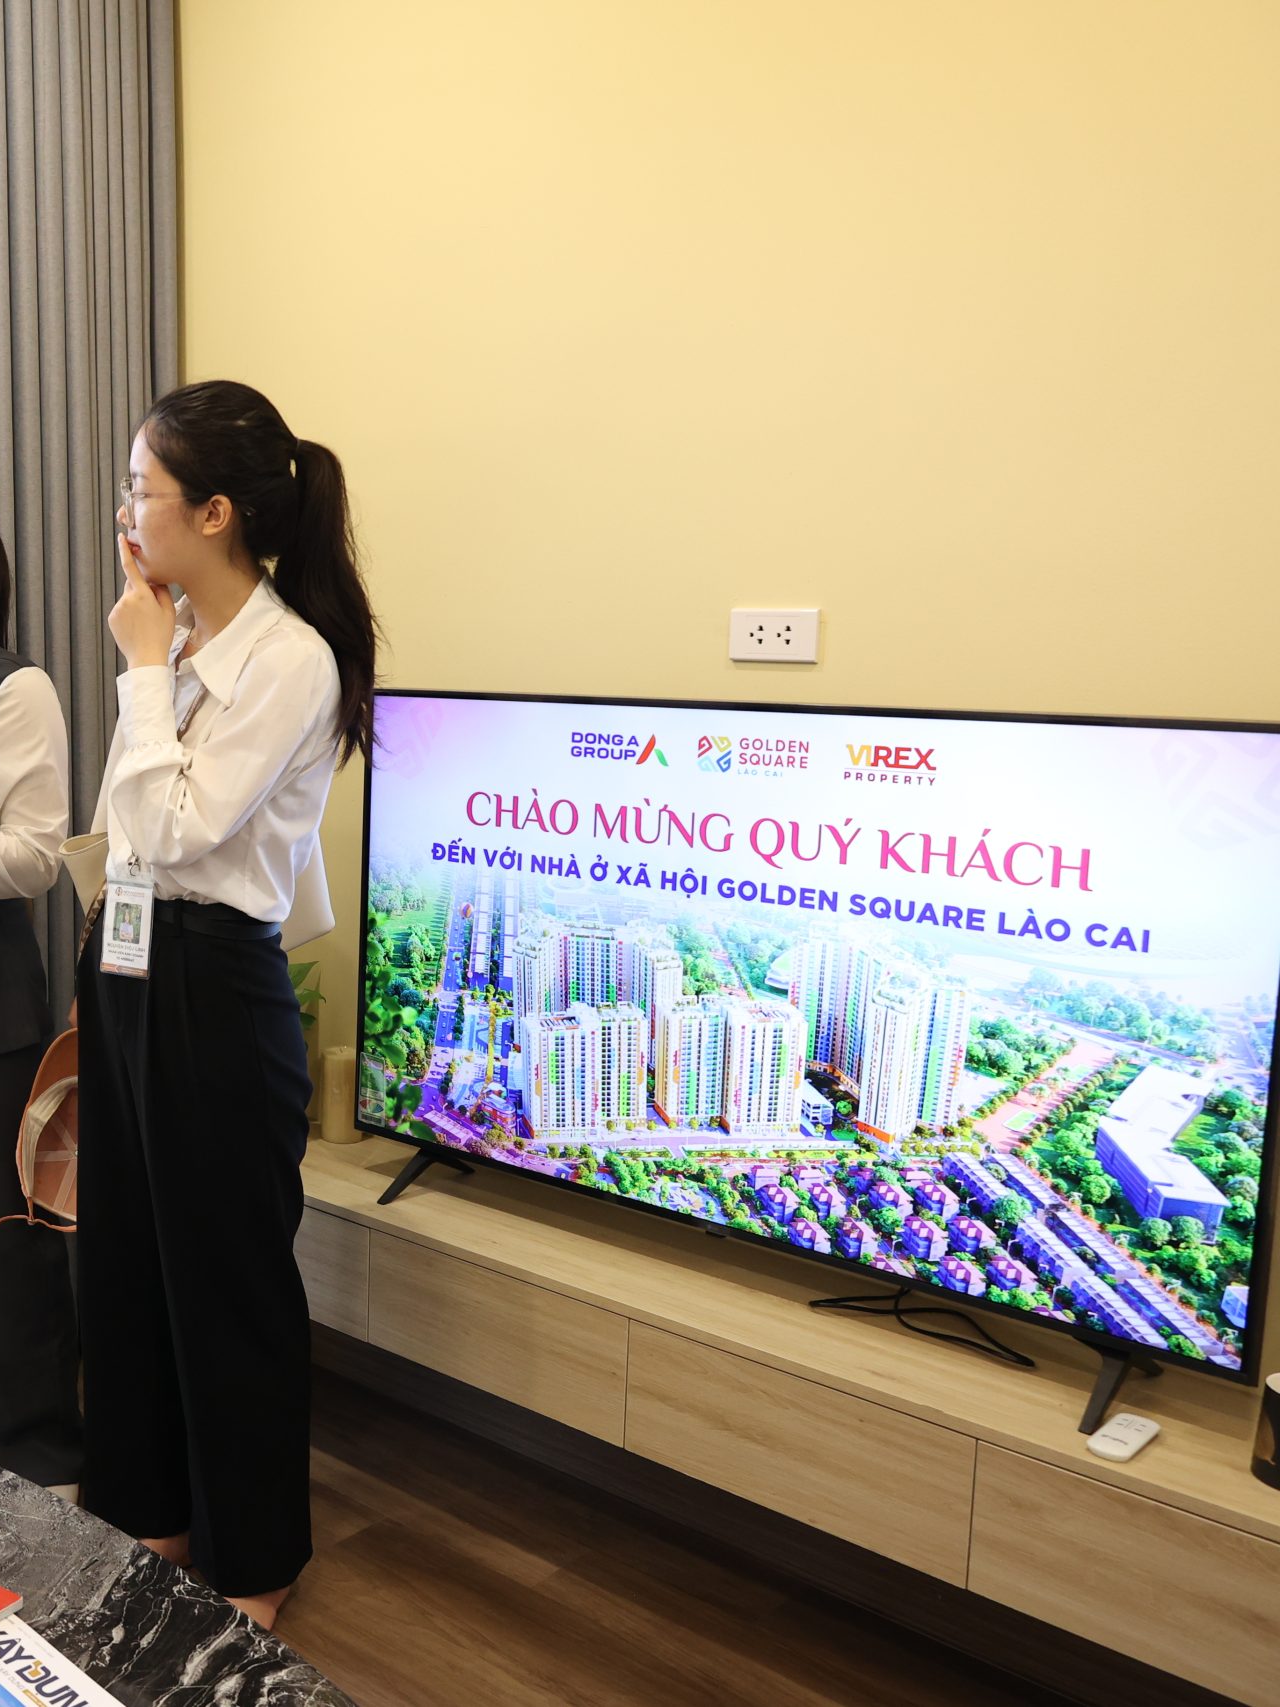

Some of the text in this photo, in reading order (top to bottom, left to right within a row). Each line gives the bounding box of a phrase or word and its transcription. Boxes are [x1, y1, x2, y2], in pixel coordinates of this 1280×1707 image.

[570, 746, 637, 760] GROUP
[739, 737, 810, 754] GOLDEN
[738, 753, 809, 769] SQUARE
[846, 744, 937, 770] VIREX
[843, 772, 936, 786] PROPERTY
[466, 788, 1094, 892] CHÀO MỪNG QUÝ KHÁCH
[431, 837, 1150, 953] ĐẾN VỚI NHÀ Ở XÃ HỘI GOLDEN SQUARE LÀO CAI
